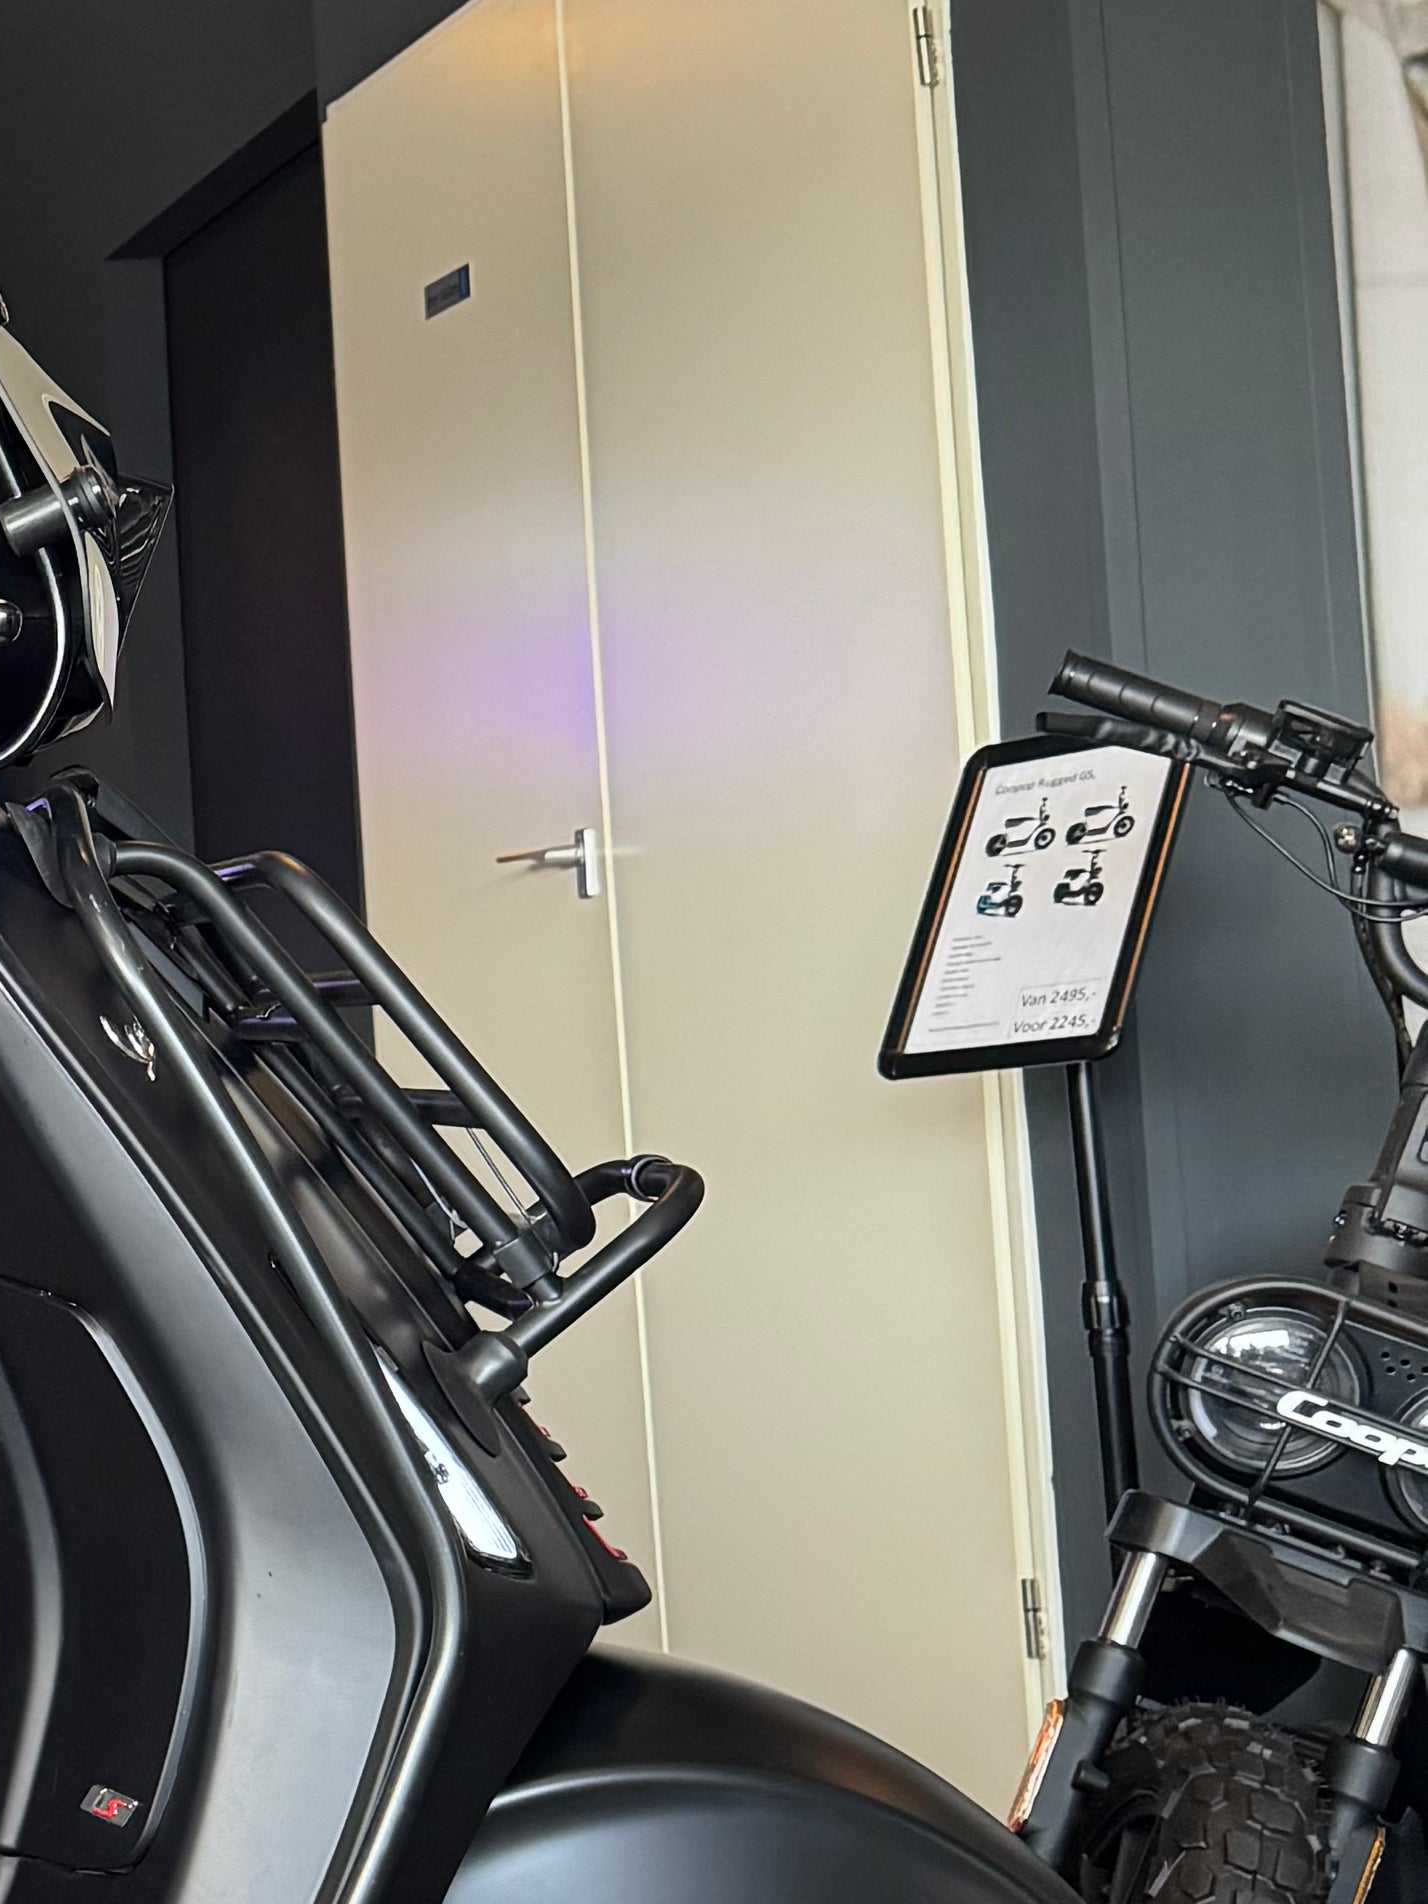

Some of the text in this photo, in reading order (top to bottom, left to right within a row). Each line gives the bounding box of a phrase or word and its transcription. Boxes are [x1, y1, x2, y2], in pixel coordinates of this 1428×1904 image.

[1022, 987, 1097, 1007] Van 2495,-
[1014, 1014, 1096, 1033] Voor 2245,-
